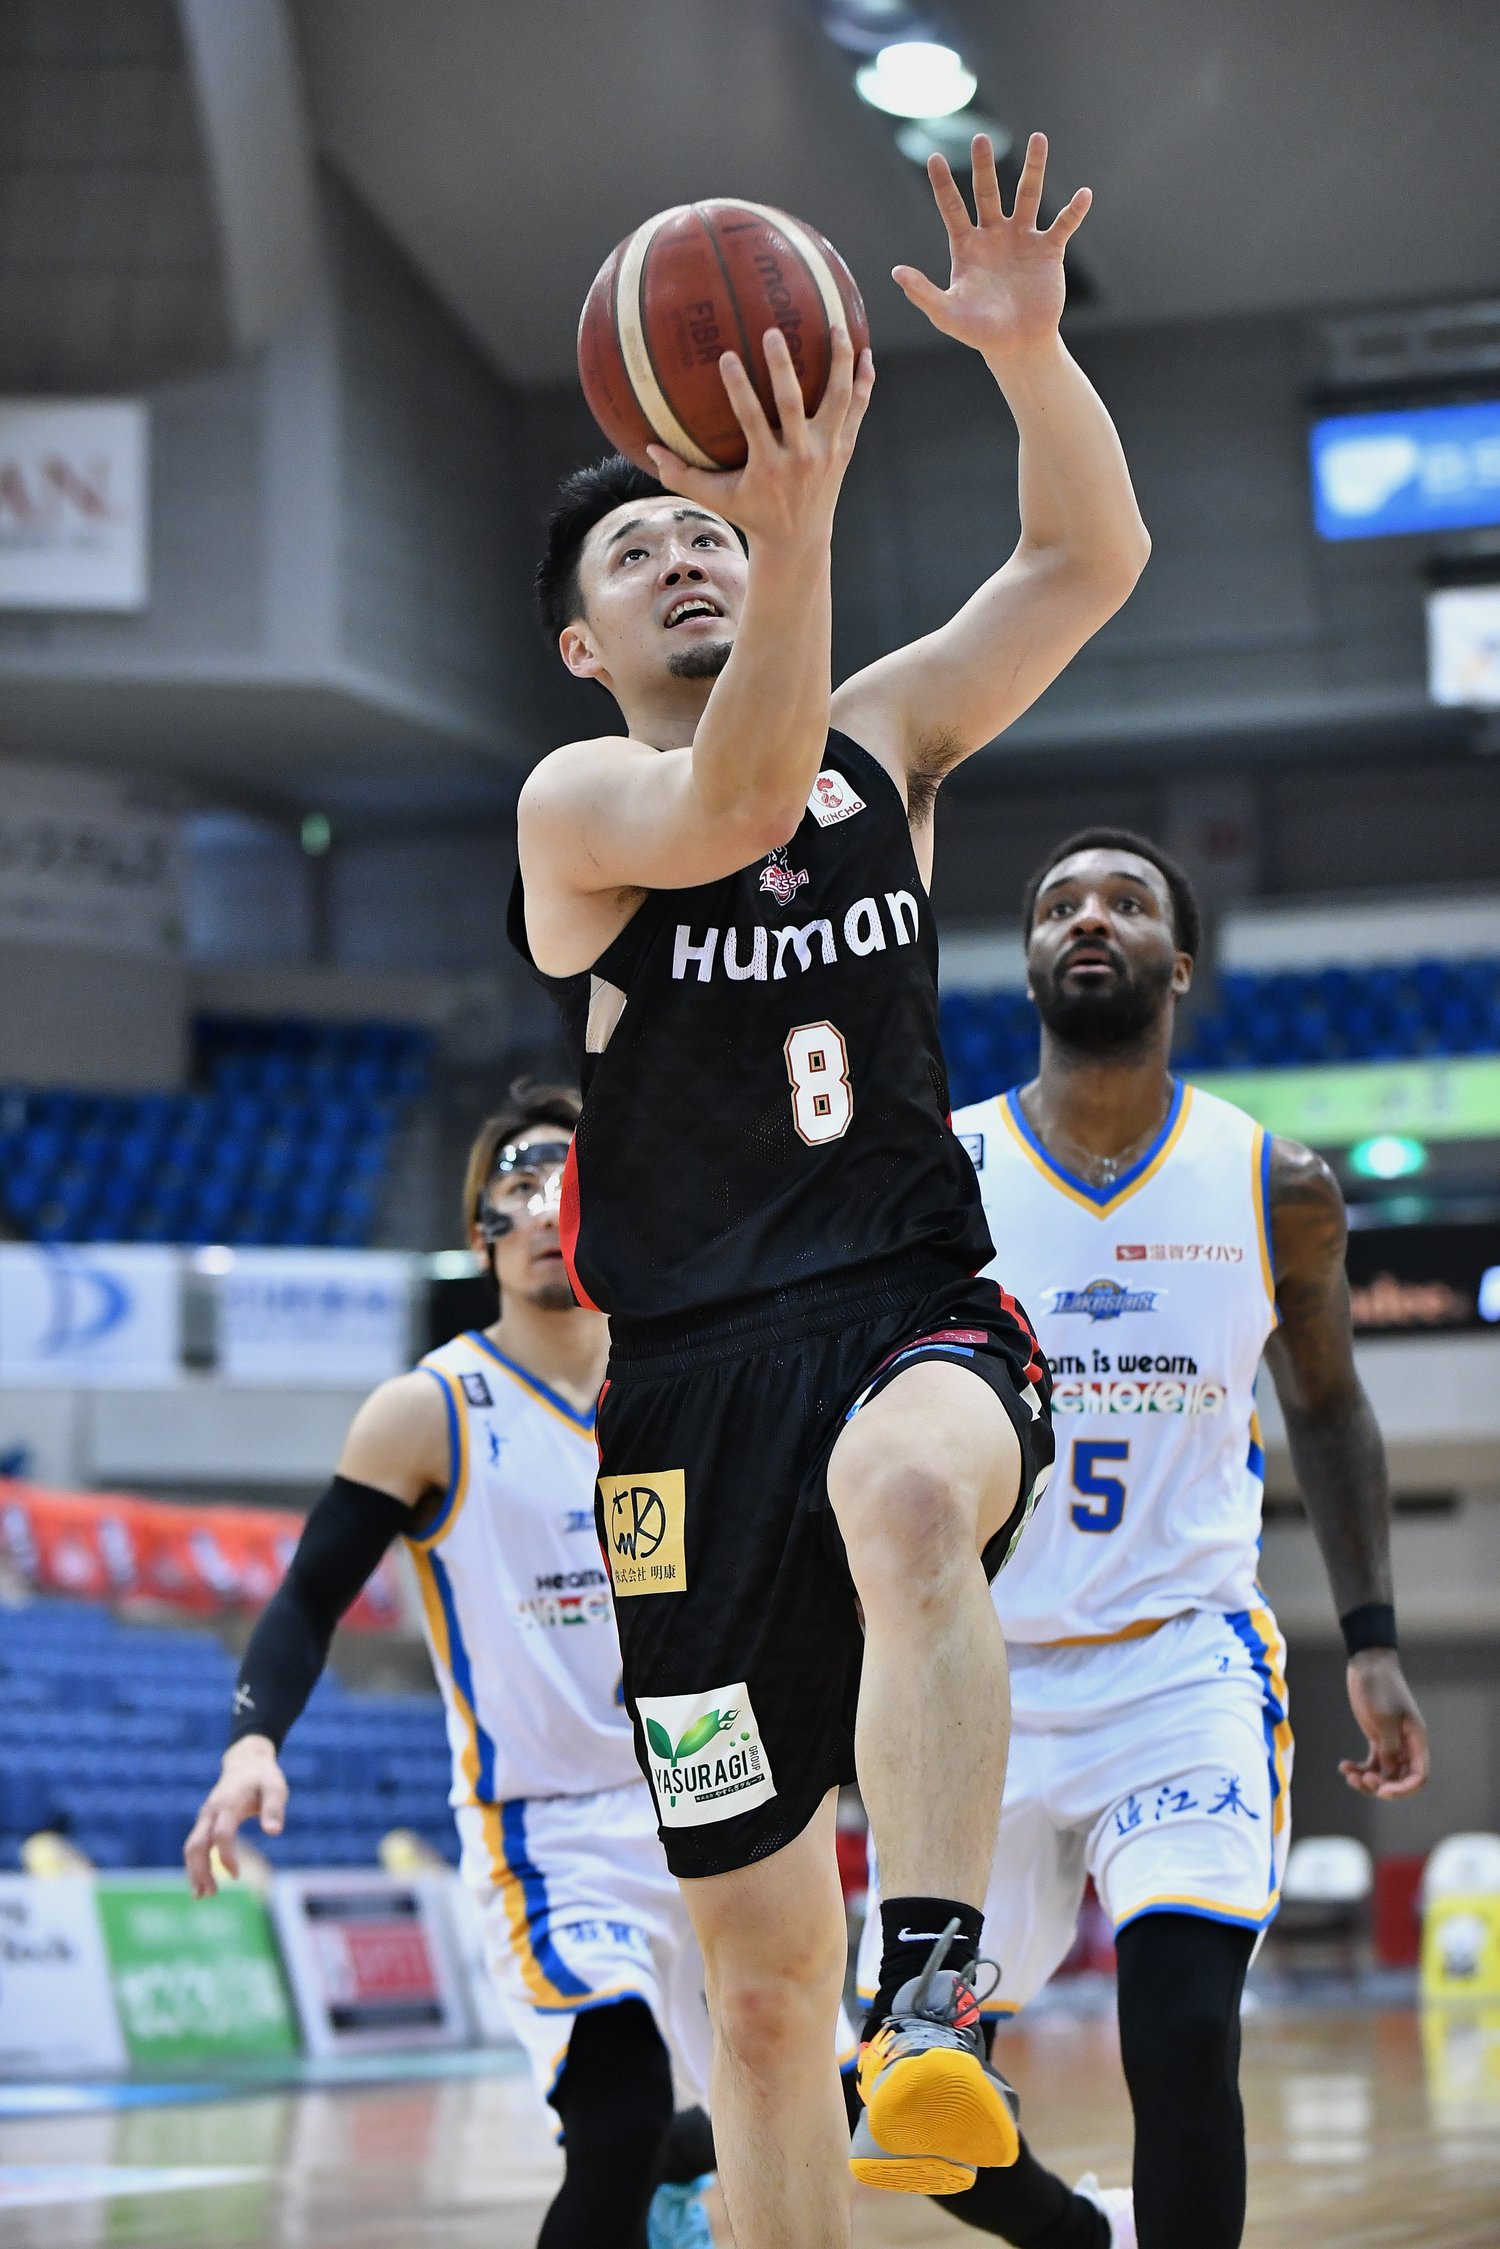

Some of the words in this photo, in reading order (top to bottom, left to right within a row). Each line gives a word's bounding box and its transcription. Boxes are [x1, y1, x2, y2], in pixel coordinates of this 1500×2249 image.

[818, 801, 862, 826] KINCHO
[783, 1020, 853, 1147] 8
[1092, 1348, 1111, 1374] is
[1070, 1439, 1129, 1534] 5
[650, 1564, 676, 1581] 明康
[749, 1745, 761, 1771] GROUP
[654, 1750, 749, 1794] YASURAGI
